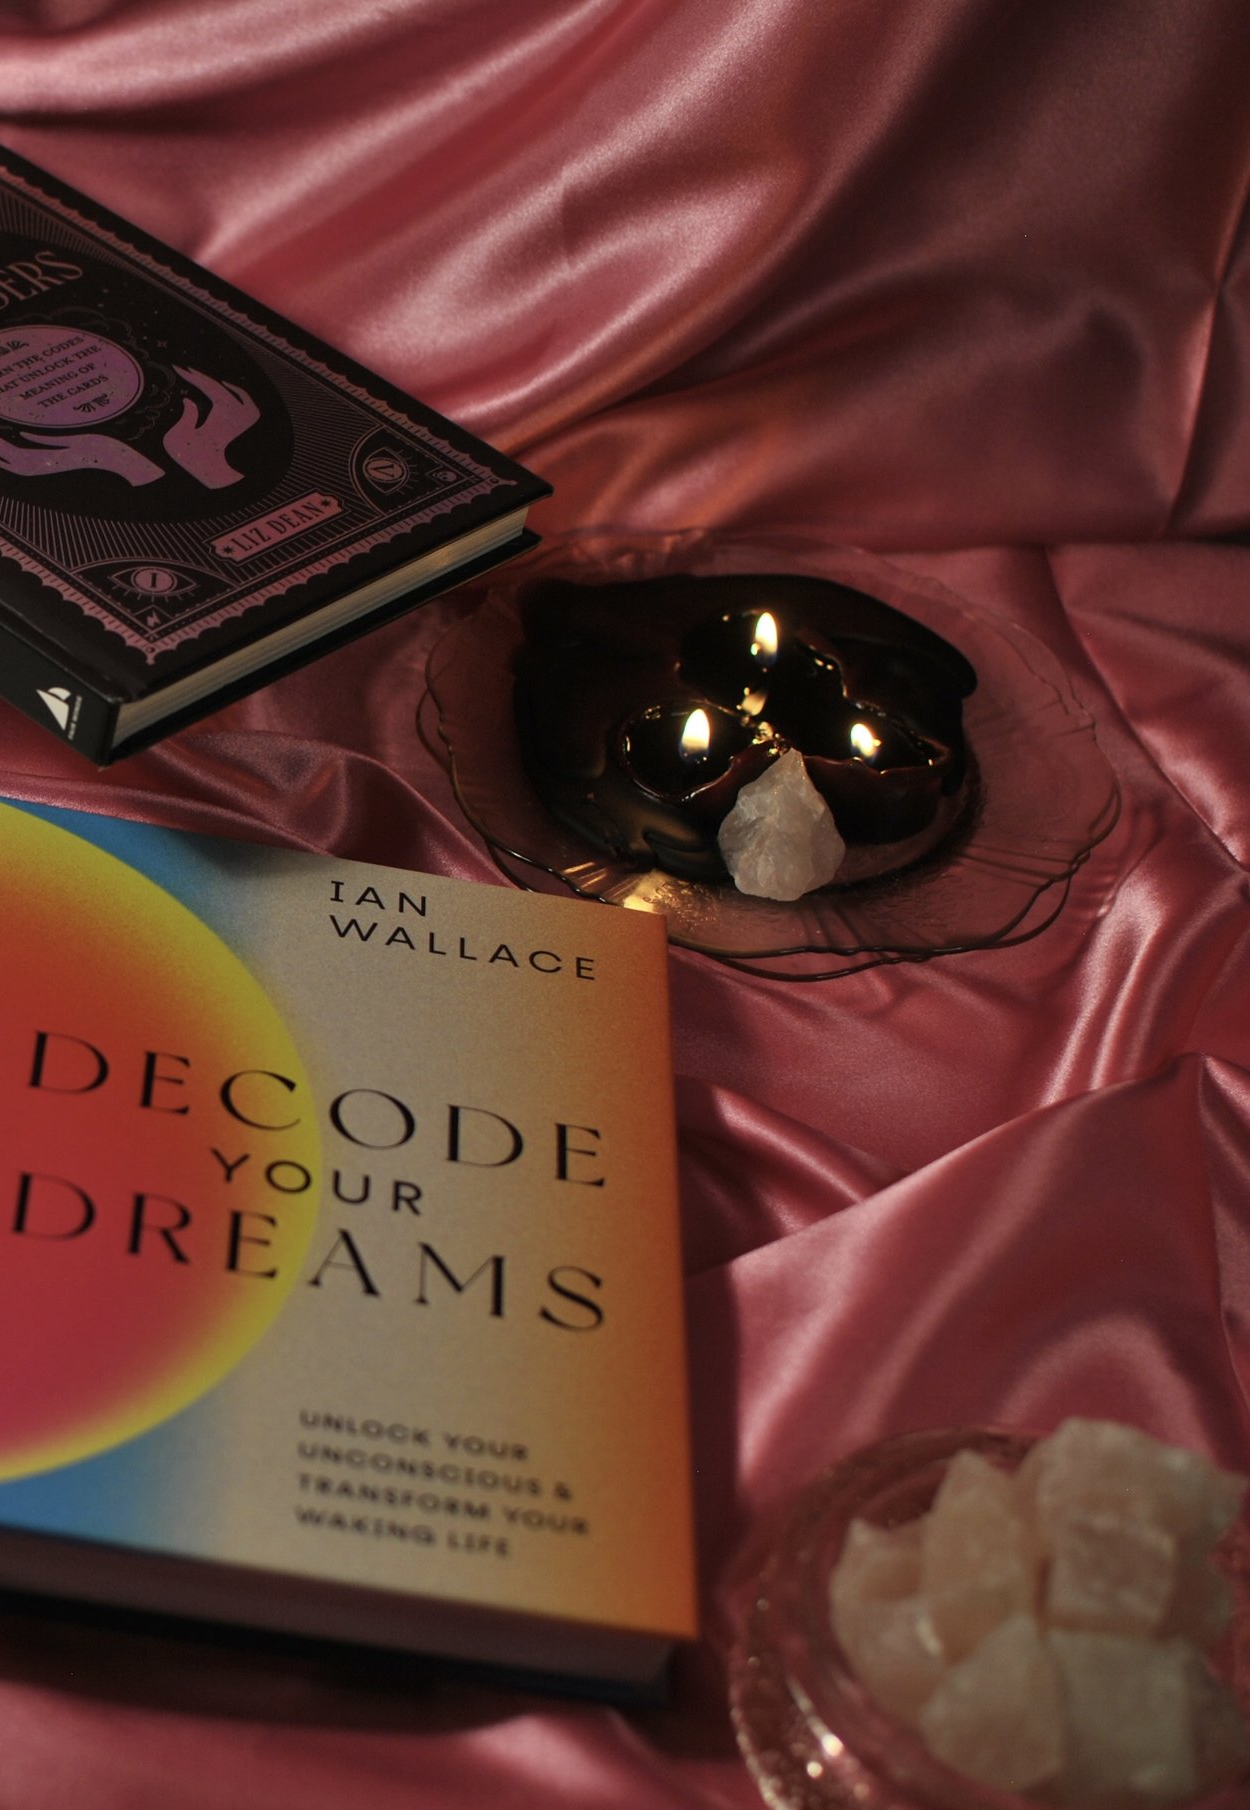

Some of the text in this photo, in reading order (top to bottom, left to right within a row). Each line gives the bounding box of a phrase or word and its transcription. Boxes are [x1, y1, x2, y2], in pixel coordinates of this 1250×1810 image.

[13, 355, 40, 371] THE
[42, 336, 84, 358] CODES
[20, 357, 74, 383] UNLOCK
[73, 344, 101, 361] THE
[20, 362, 97, 400] MEANING OF
[38, 374, 109, 409] THE CARDS
[231, 502, 325, 551] LIZ DEAN
[330, 880, 427, 917] IAN
[329, 915, 595, 980] WALLACE
[28, 1030, 604, 1188] DECODE
[210, 1147, 422, 1217] YOUR
[11, 1172, 604, 1332] DREAMS
[299, 1410, 529, 1462] UNLOCK YOUR
[297, 1440, 543, 1496] UNCONSCIOUS
[297, 1471, 590, 1536] TRANSFORM YOUR
[295, 1504, 509, 1558] WAKING LIFE
